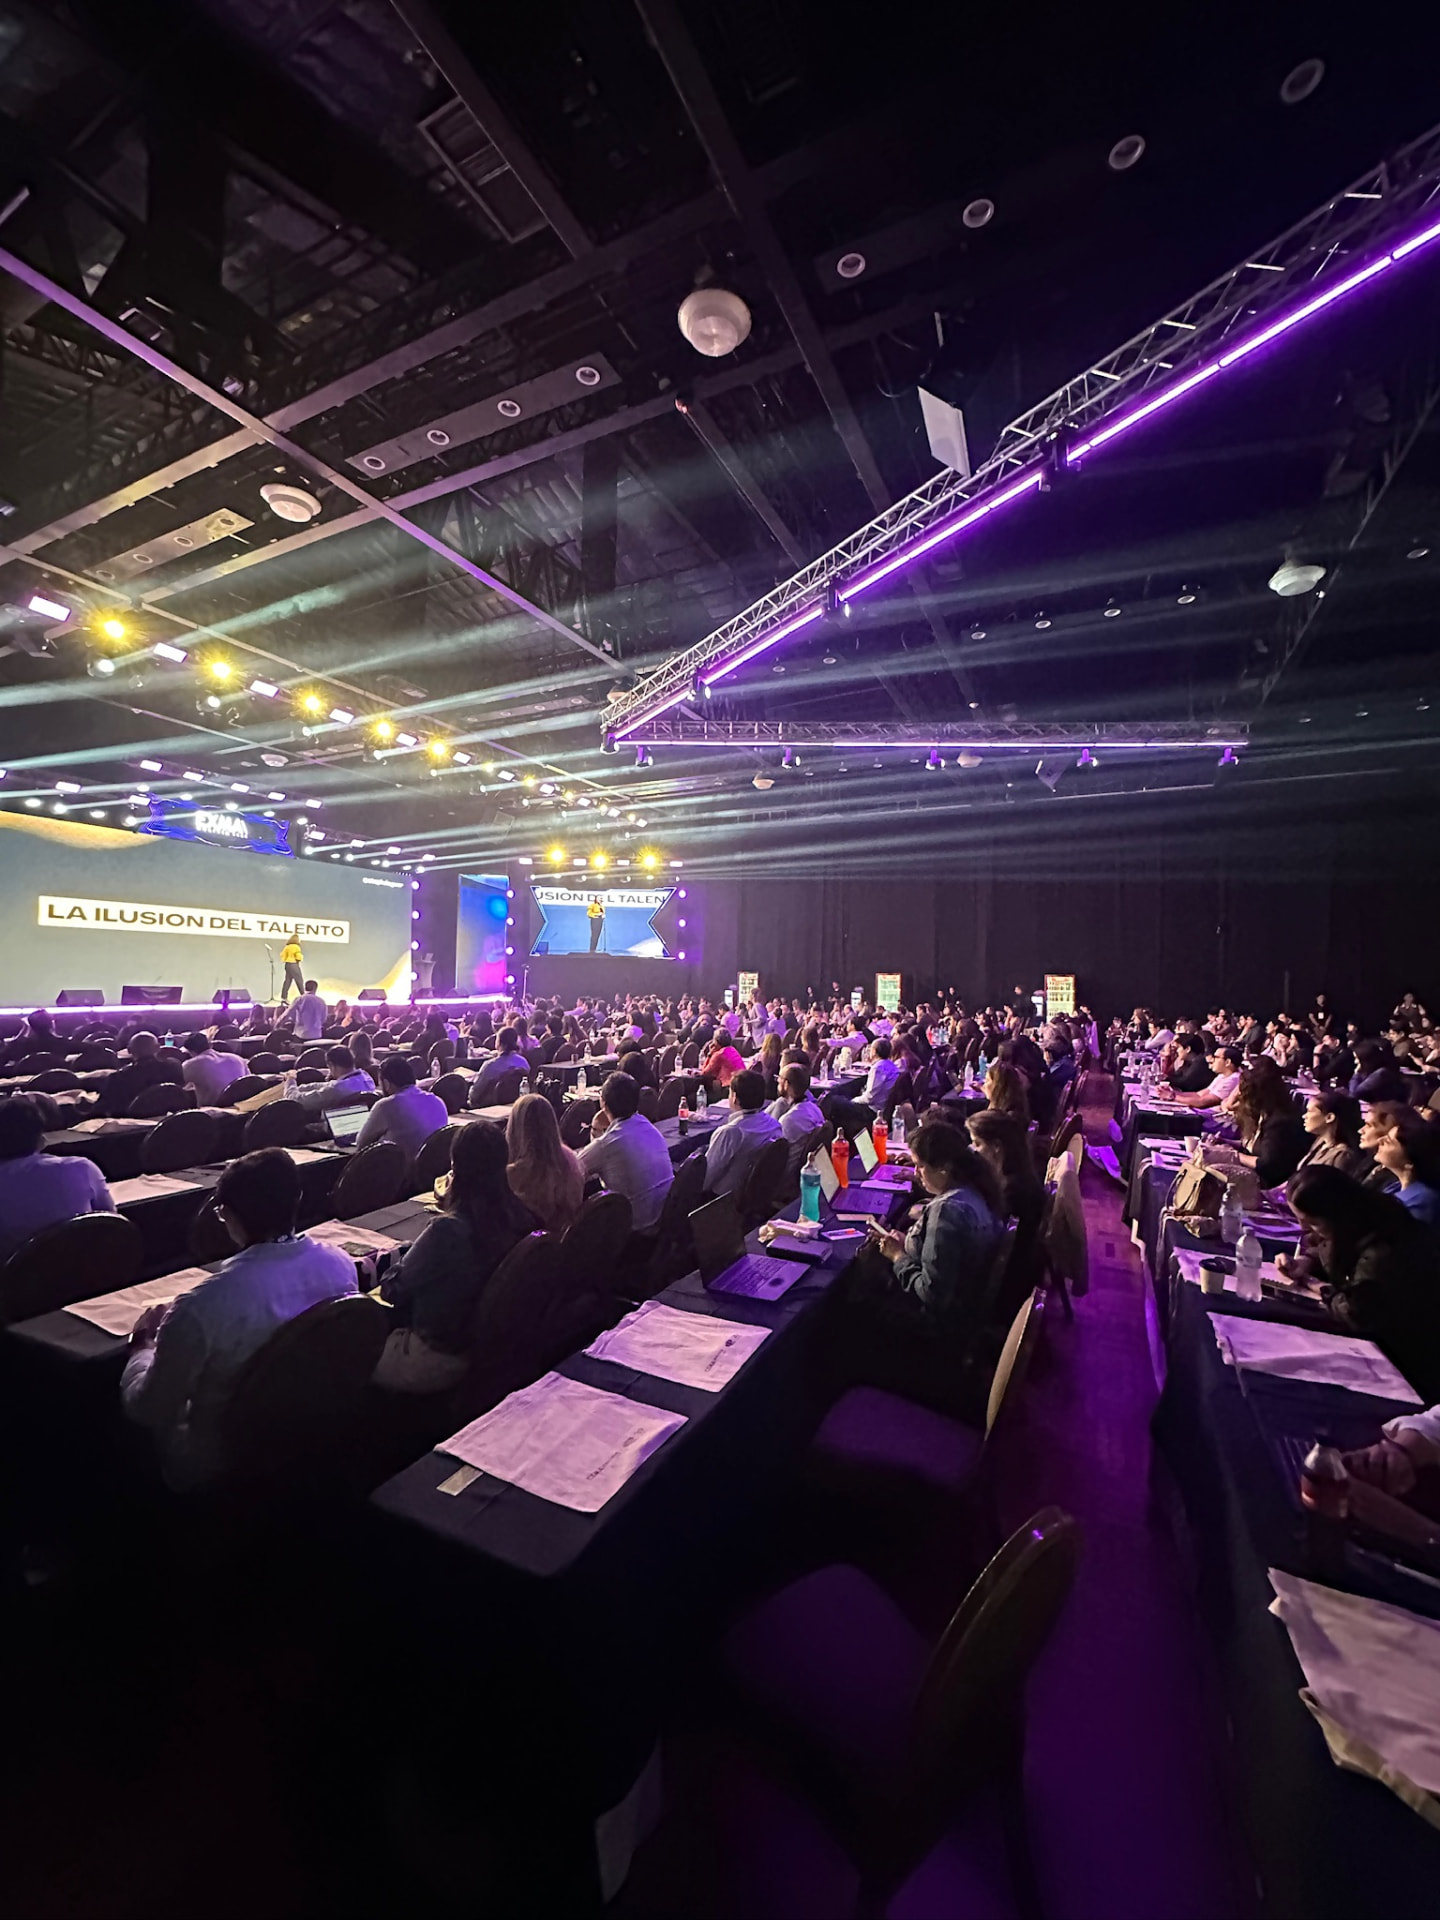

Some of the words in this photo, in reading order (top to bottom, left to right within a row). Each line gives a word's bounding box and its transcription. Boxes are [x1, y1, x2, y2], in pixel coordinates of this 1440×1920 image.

[48, 904, 87, 920] LA
[95, 908, 204, 927] ILUSION
[210, 917, 252, 930] DEL
[257, 920, 344, 937] TALENTO
